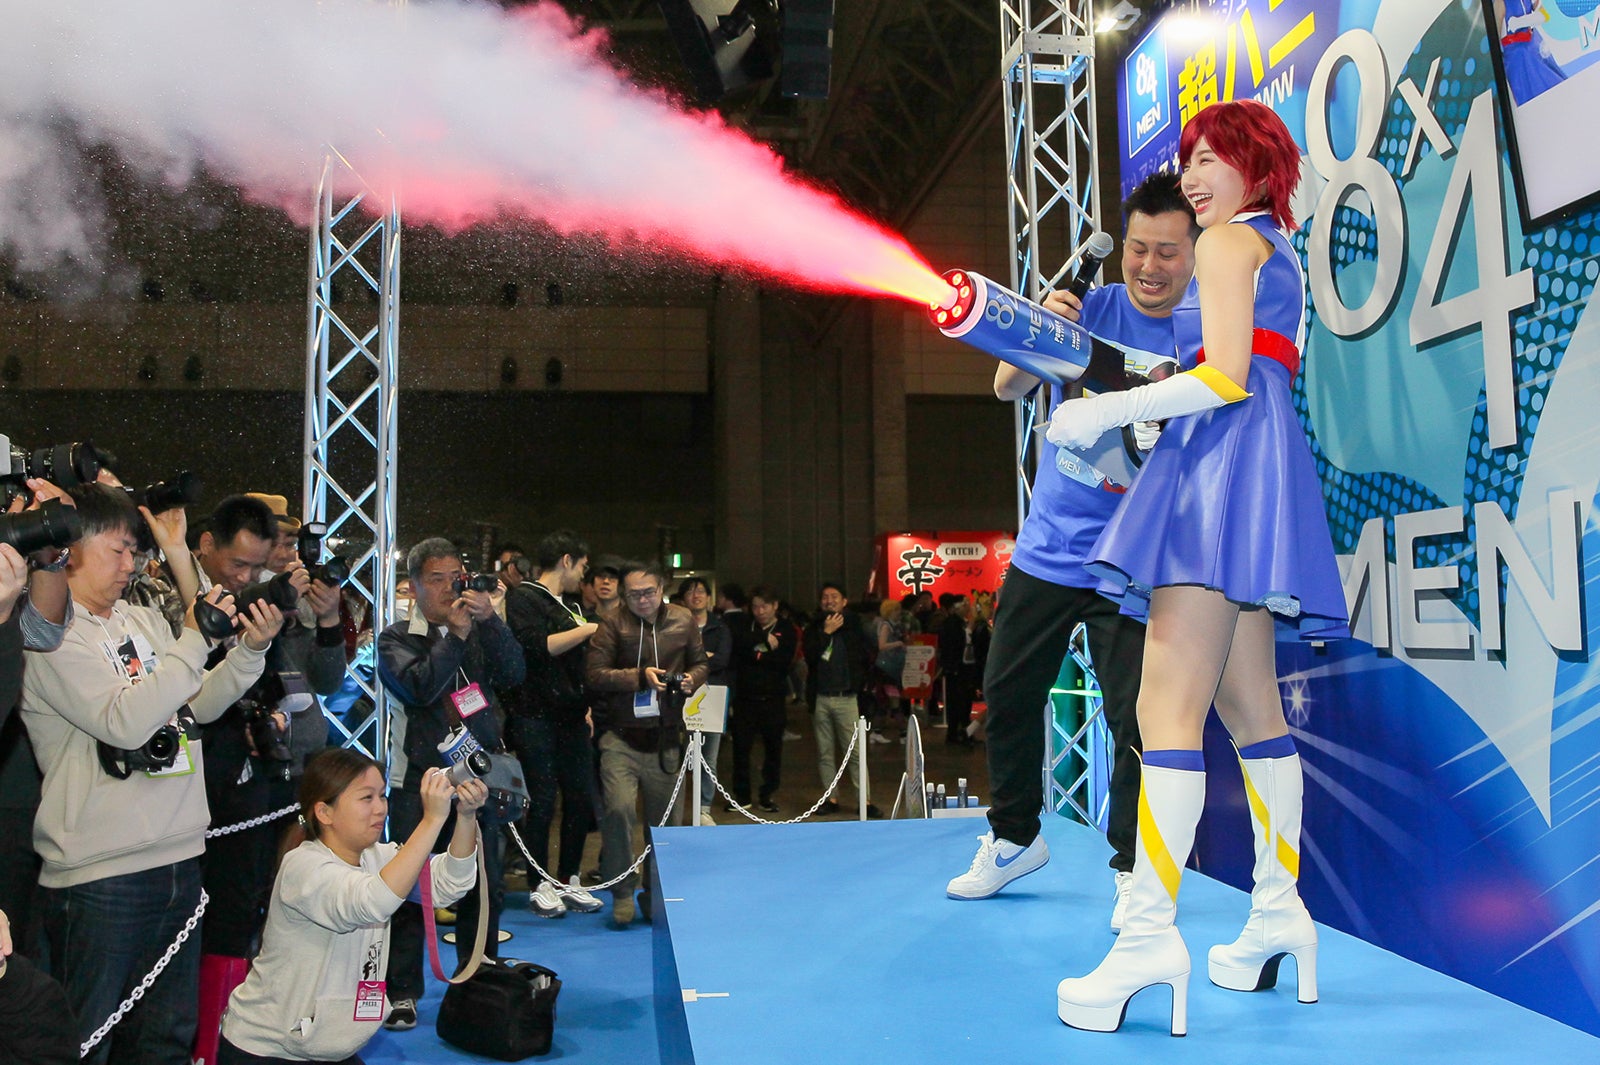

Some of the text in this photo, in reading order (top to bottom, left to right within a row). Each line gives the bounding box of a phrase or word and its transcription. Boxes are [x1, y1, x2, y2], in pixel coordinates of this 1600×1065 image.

[1136, 101, 1161, 140] MEN
[1059, 456, 1081, 476] MEN
[897, 545, 944, 596] 辛
[947, 566, 983, 578] ラーメン
